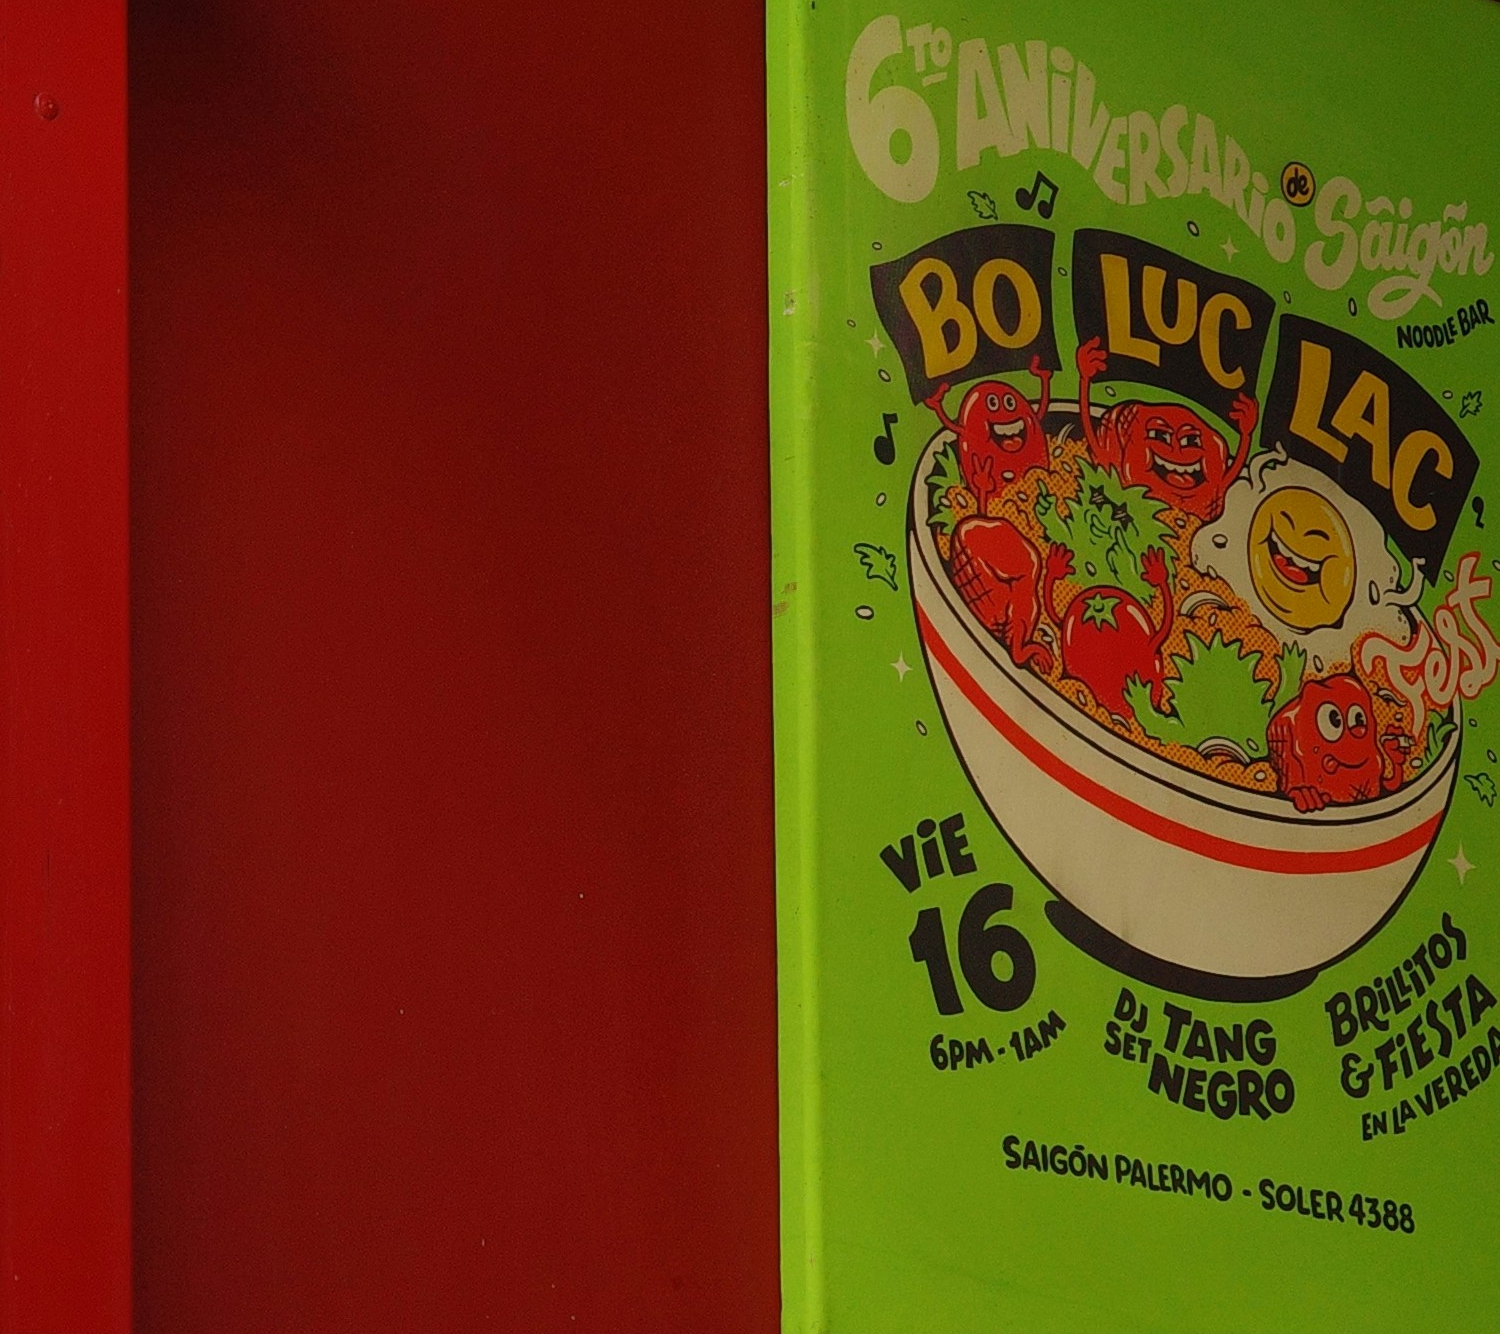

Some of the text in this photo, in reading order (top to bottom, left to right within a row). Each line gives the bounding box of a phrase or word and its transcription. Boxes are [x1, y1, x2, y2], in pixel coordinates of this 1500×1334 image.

[1397, 299, 1495, 348] NOODLE BAR
[900, 254, 1454, 531] BO LUC LAC
[908, 883, 1036, 1016] 16
[1104, 1021, 1295, 1121] SET NEGRO
[1114, 987, 1276, 1066] DJ TANG
[1341, 1052, 1374, 1098] &
[1362, 1111, 1388, 1141] EN
[1392, 1099, 1416, 1134] LA
[1002, 1135, 1108, 1180] SAIGÓN
[1116, 1154, 1232, 1201] PALERMO
[1259, 1179, 1344, 1222] SOLER
[1349, 1193, 1416, 1234] 4388
